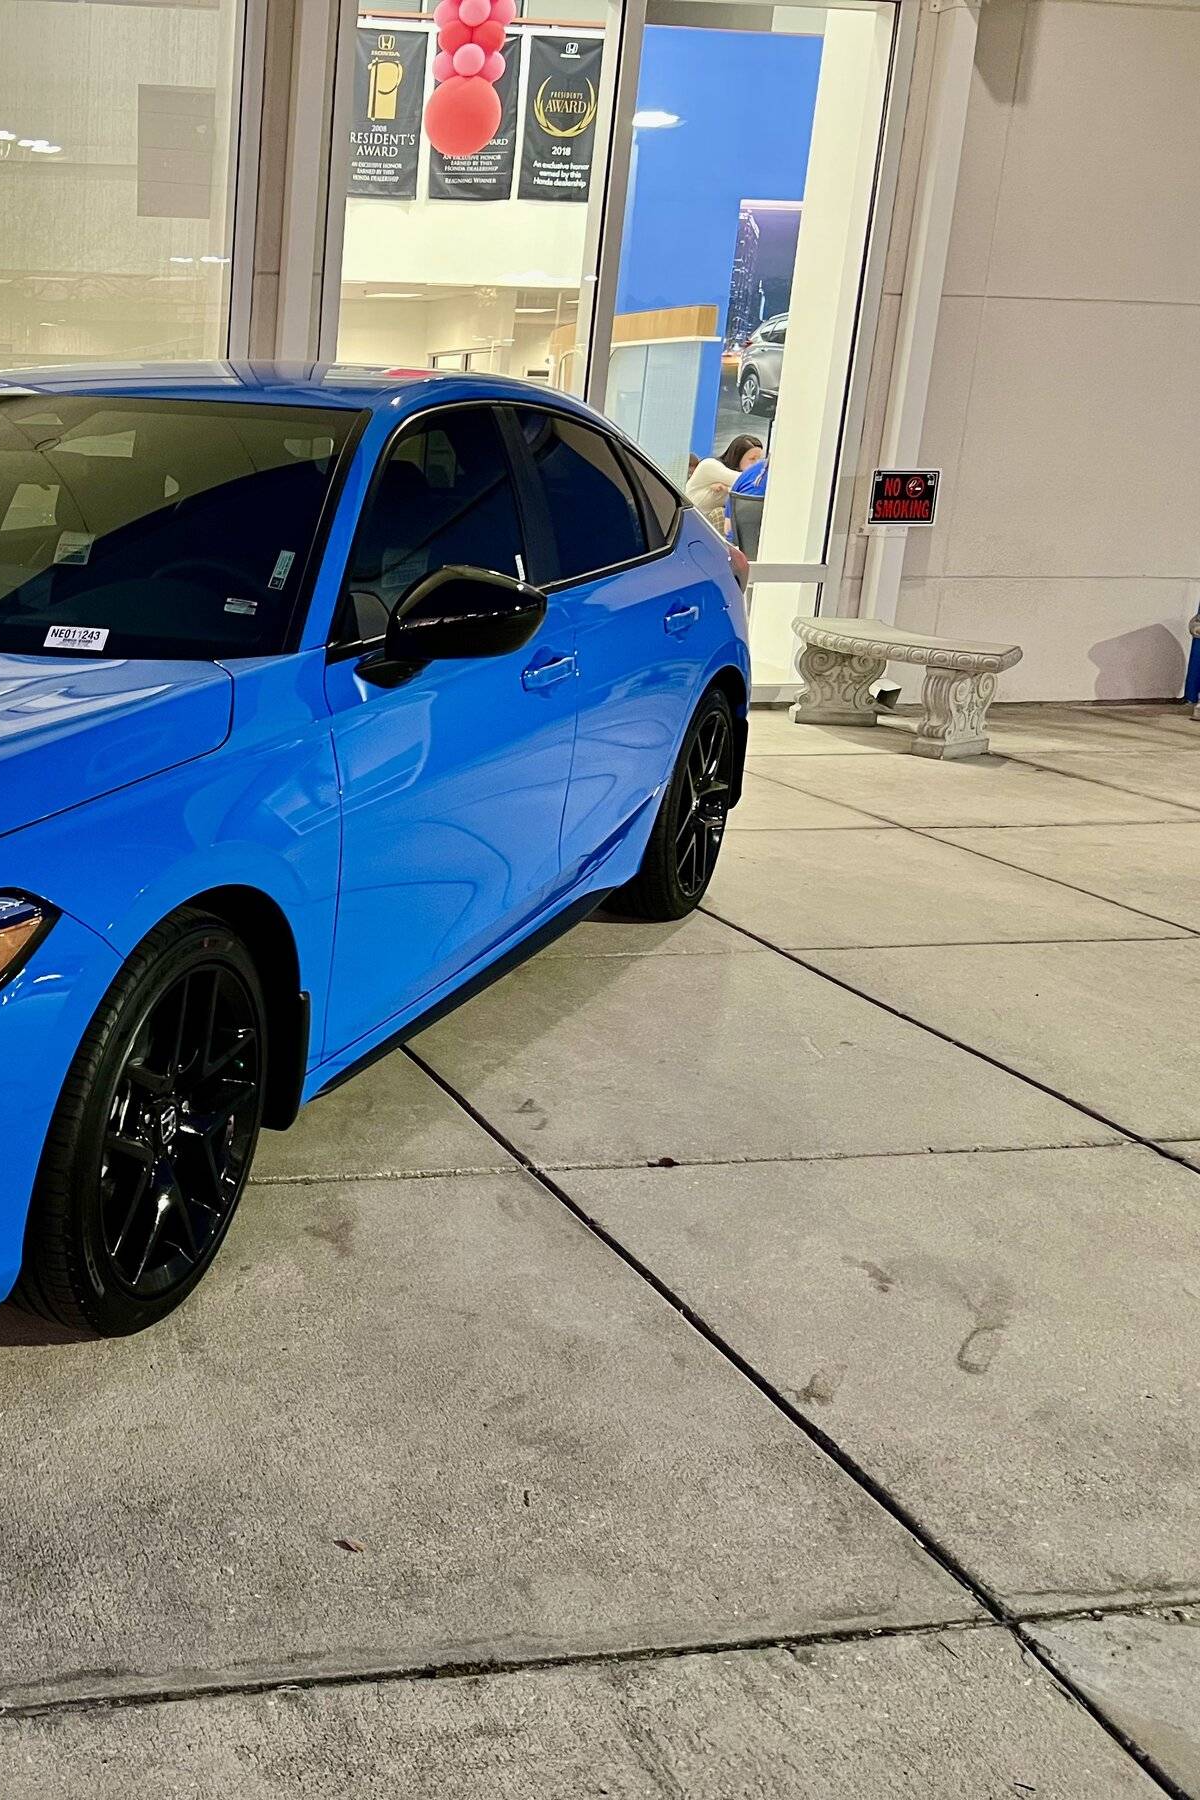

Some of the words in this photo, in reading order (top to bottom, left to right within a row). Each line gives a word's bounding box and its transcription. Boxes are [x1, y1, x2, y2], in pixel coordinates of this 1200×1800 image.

[545, 99, 587, 113] AWARD
[350, 132, 416, 145] RESIDENT'S
[489, 138, 509, 146] WARD
[356, 145, 398, 157] AWARD
[551, 146, 572, 156] 2018
[542, 161, 569, 169] exclusive
[570, 162, 589, 170] honor
[561, 170, 569, 180] by
[533, 177, 553, 186] Honda
[553, 178, 586, 189] dealership
[884, 477, 901, 496] NO
[874, 500, 930, 518] SMOKING
